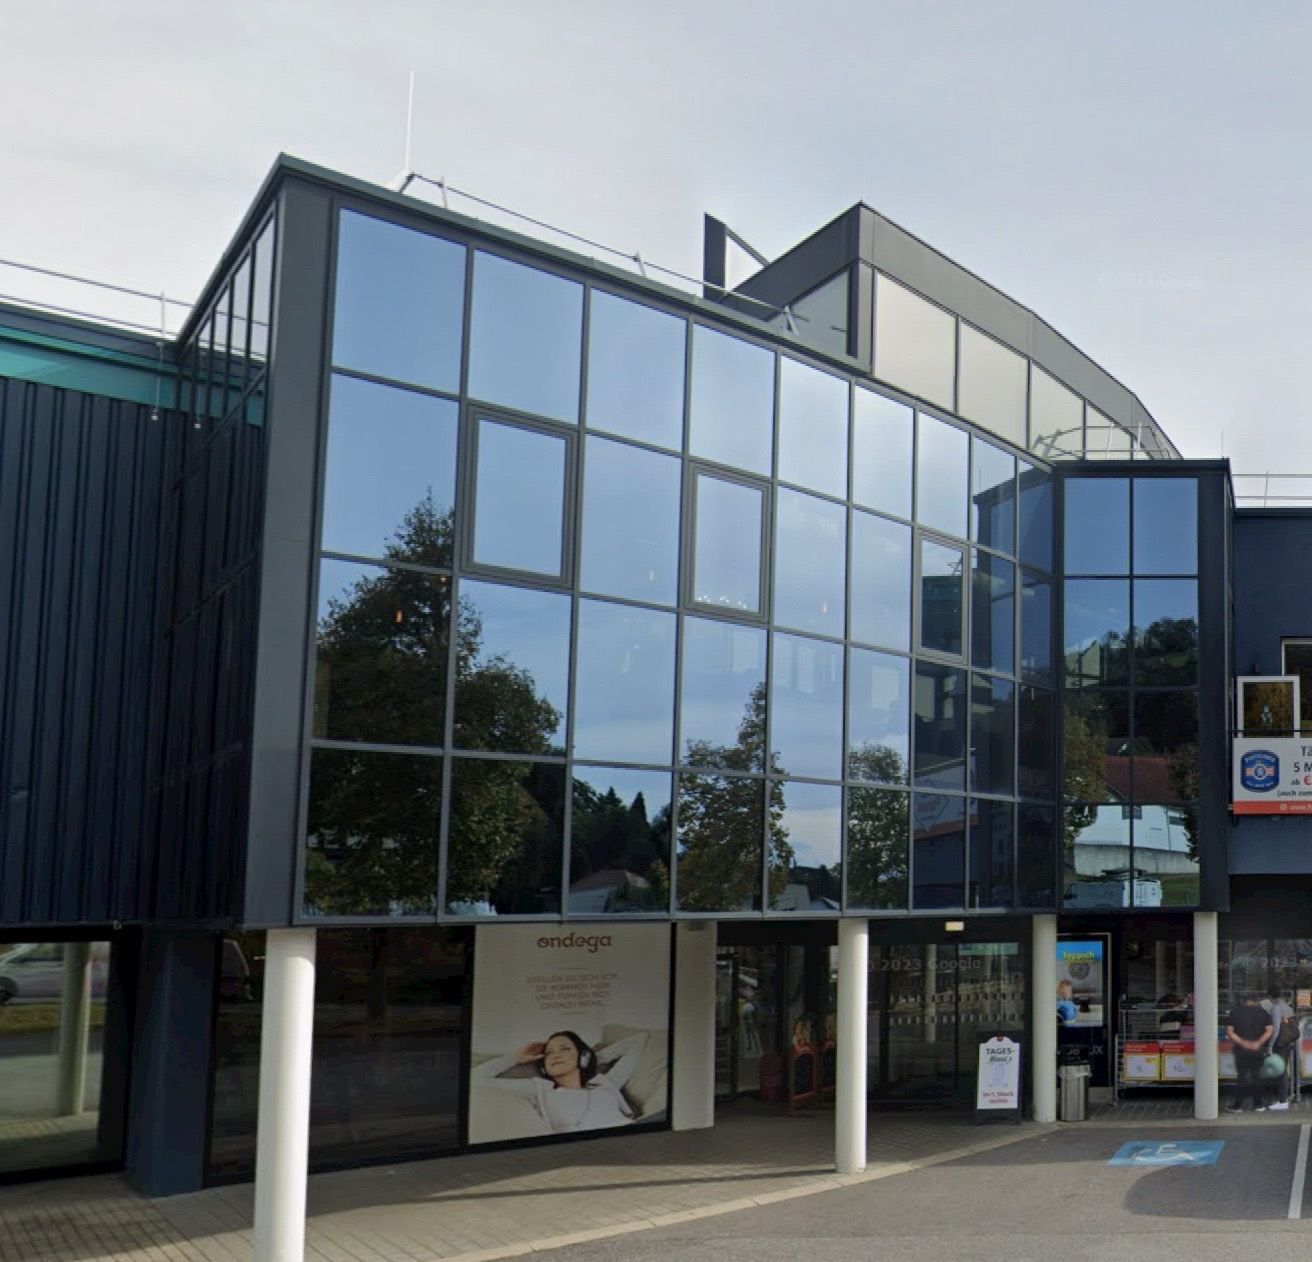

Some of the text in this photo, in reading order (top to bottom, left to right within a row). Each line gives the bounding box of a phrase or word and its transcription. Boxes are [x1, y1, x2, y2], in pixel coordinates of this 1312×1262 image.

[1293, 761, 1301, 773] 5
[1290, 778, 1301, 786] ab
[537, 932, 612, 953] ondega
[1063, 951, 1096, 962] Teppich
